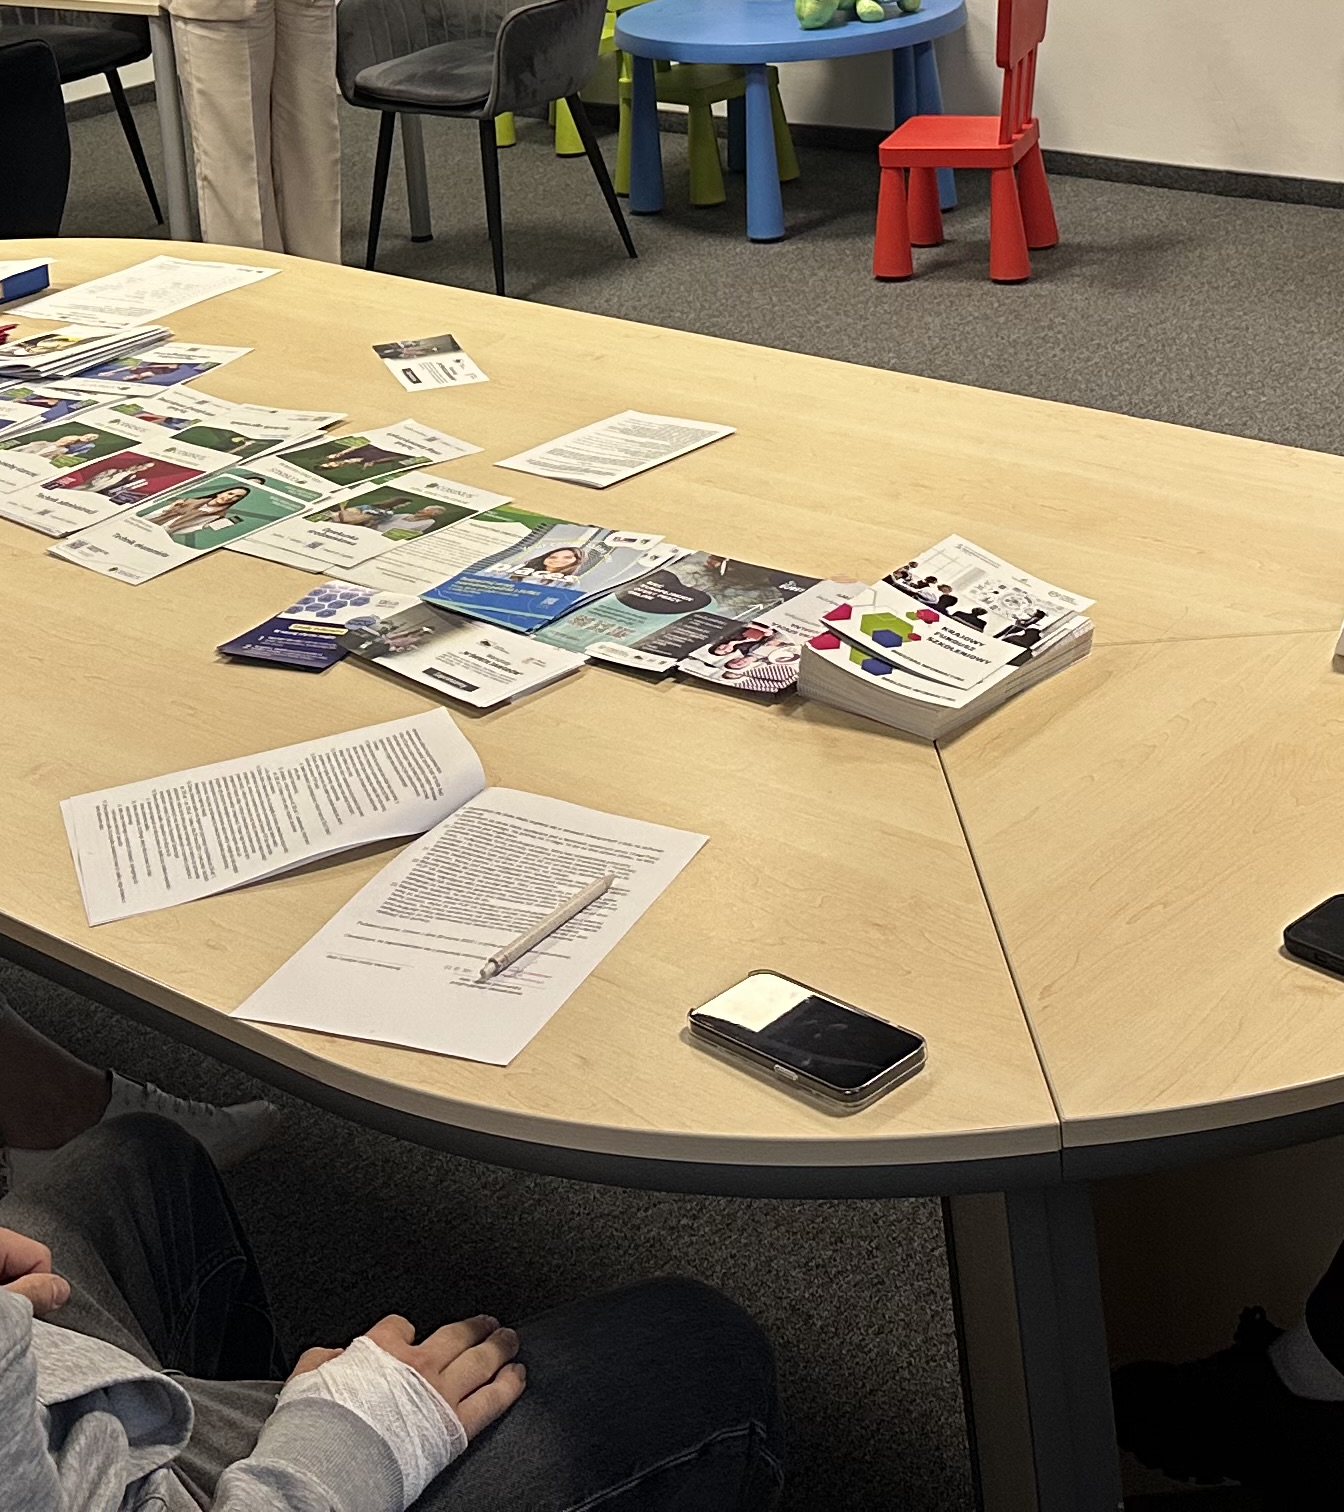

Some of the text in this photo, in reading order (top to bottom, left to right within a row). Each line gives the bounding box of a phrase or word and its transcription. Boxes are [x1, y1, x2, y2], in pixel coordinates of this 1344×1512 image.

[933, 630, 978, 653] FUNDUSZ
[941, 625, 987, 648] KRAJOWY
[926, 635, 993, 666] SZKOLENIOWY
